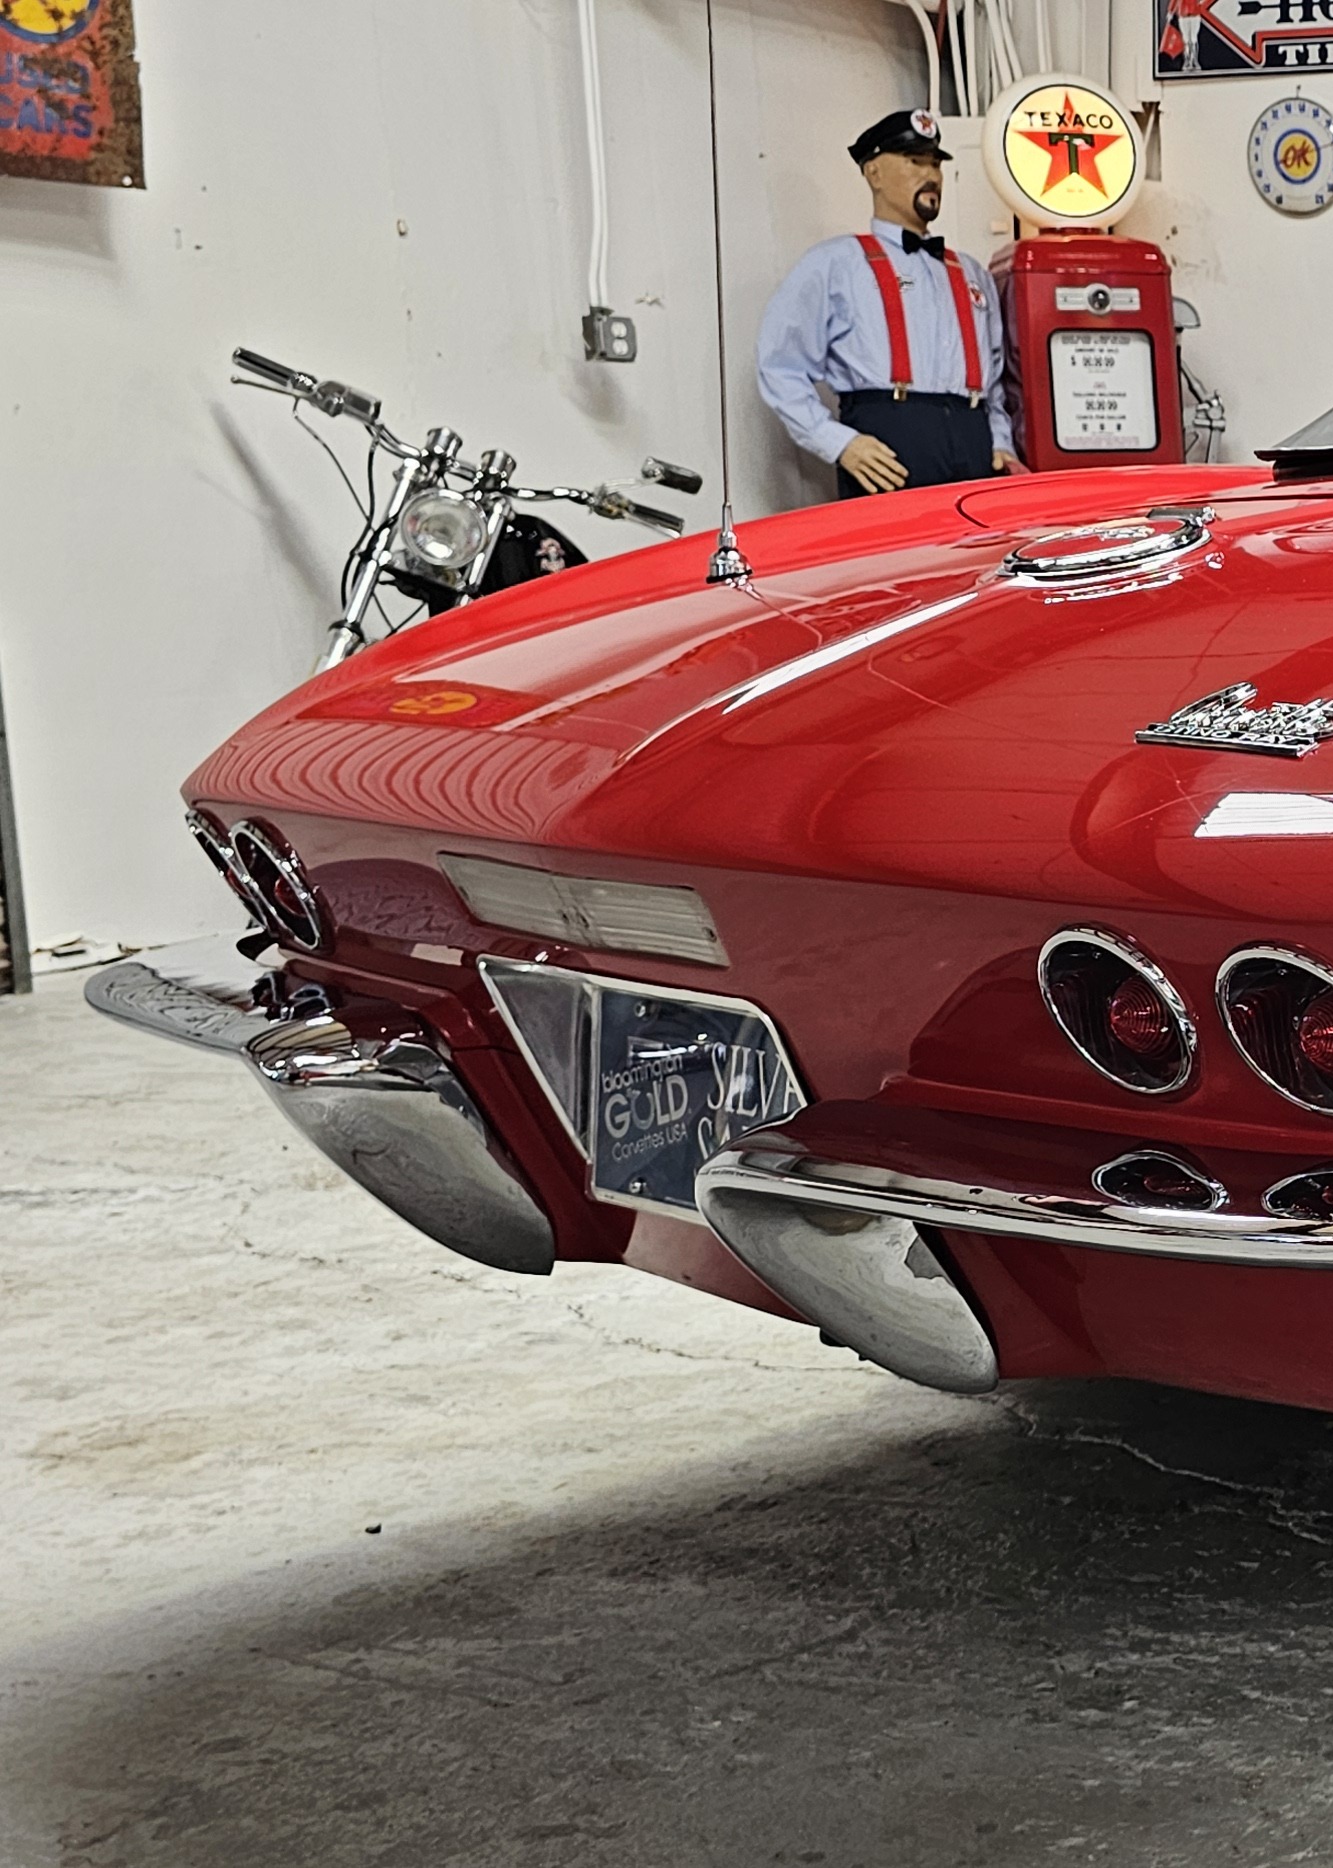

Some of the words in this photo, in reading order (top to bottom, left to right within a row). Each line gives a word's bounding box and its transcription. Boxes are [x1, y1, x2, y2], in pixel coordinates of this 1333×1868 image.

[1023, 111, 1114, 130] TEXACO
[604, 1074, 689, 1139] GOLD
[612, 1132, 666, 1161] Corvettes
[666, 1122, 688, 1144] USA
